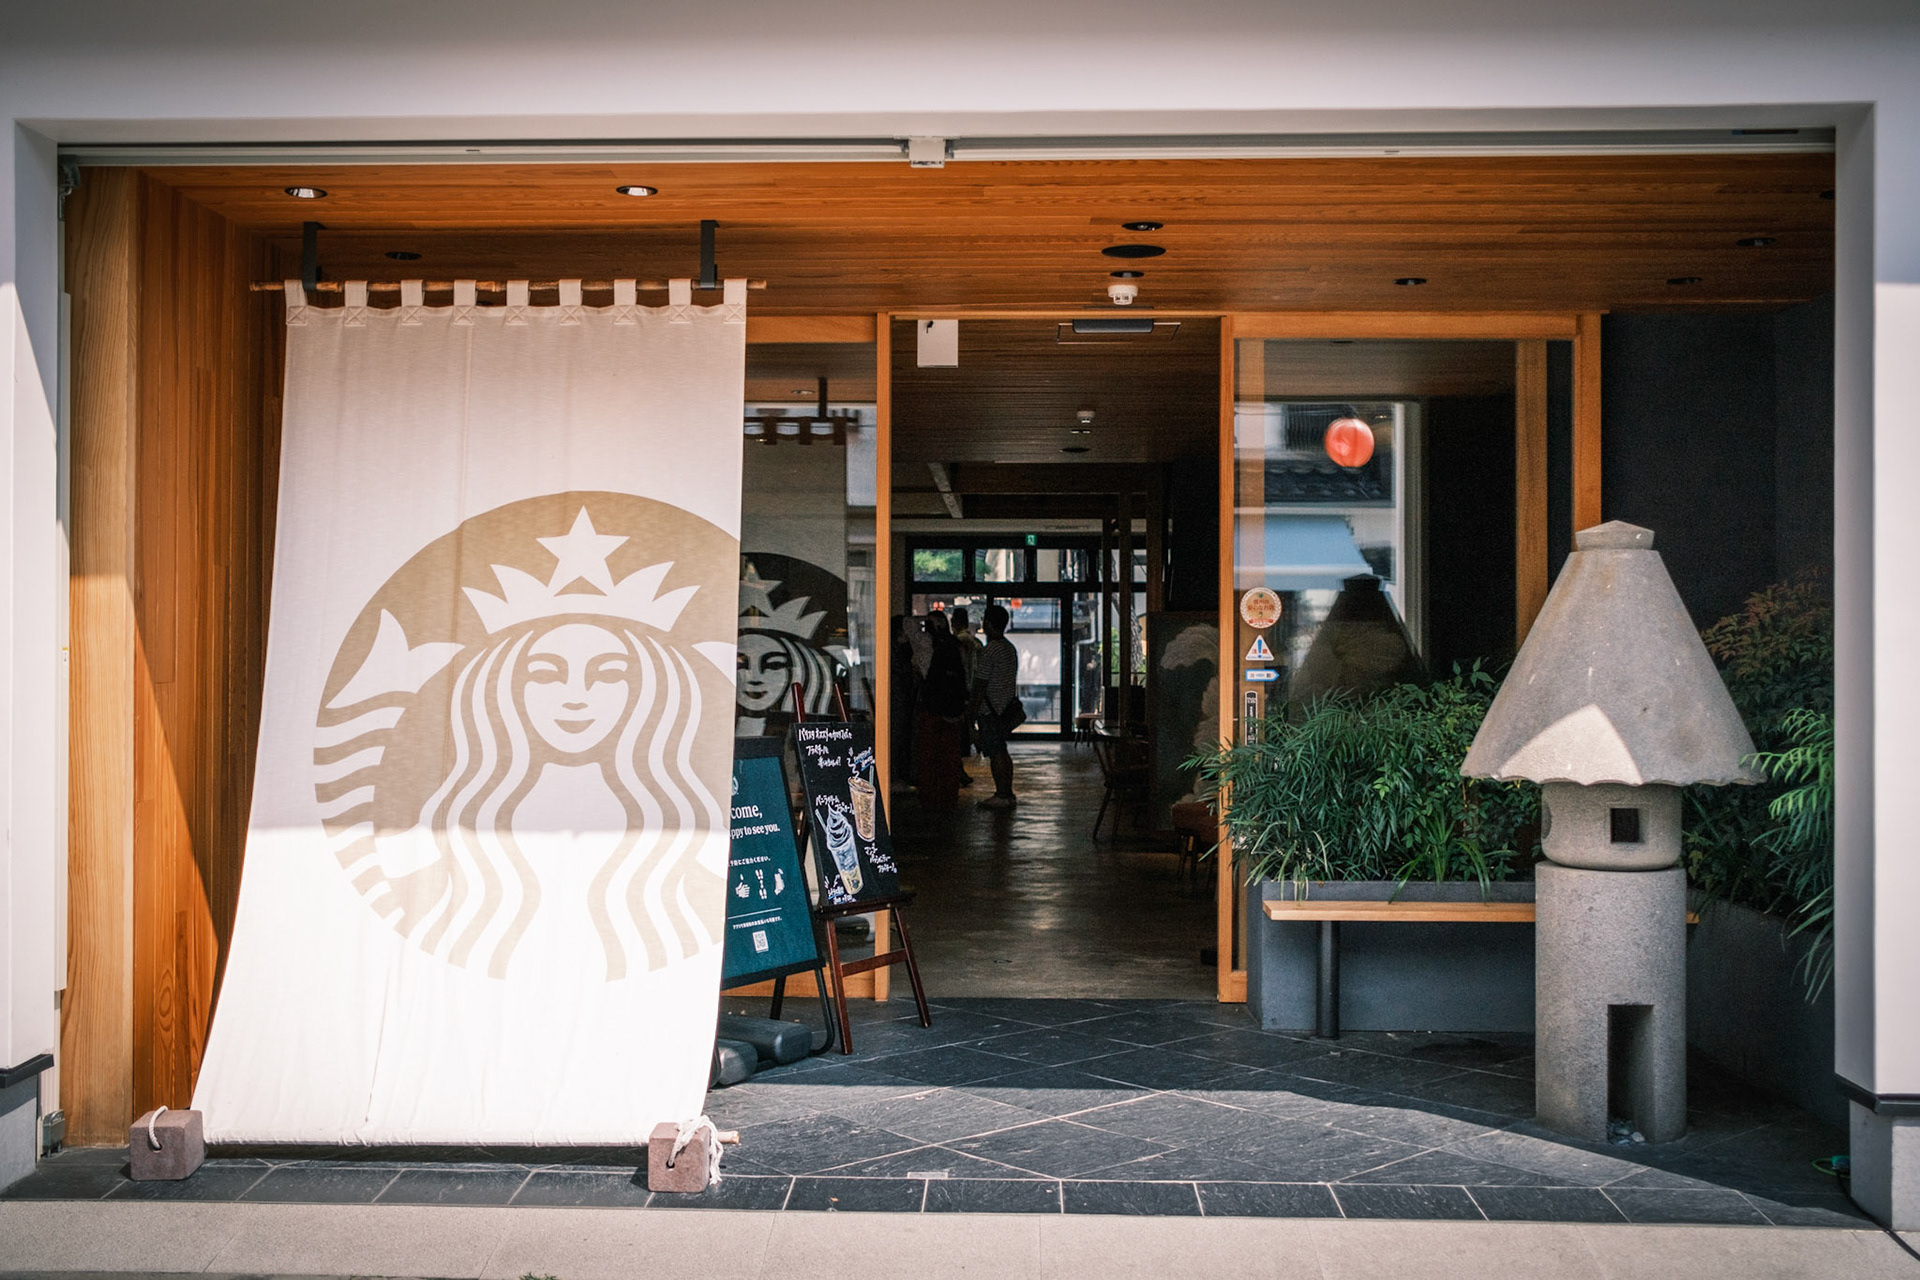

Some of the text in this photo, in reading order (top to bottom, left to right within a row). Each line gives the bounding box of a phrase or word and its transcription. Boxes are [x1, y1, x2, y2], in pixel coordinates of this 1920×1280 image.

[730, 804, 763, 820] come,
[730, 823, 781, 840] ppy to see you.
